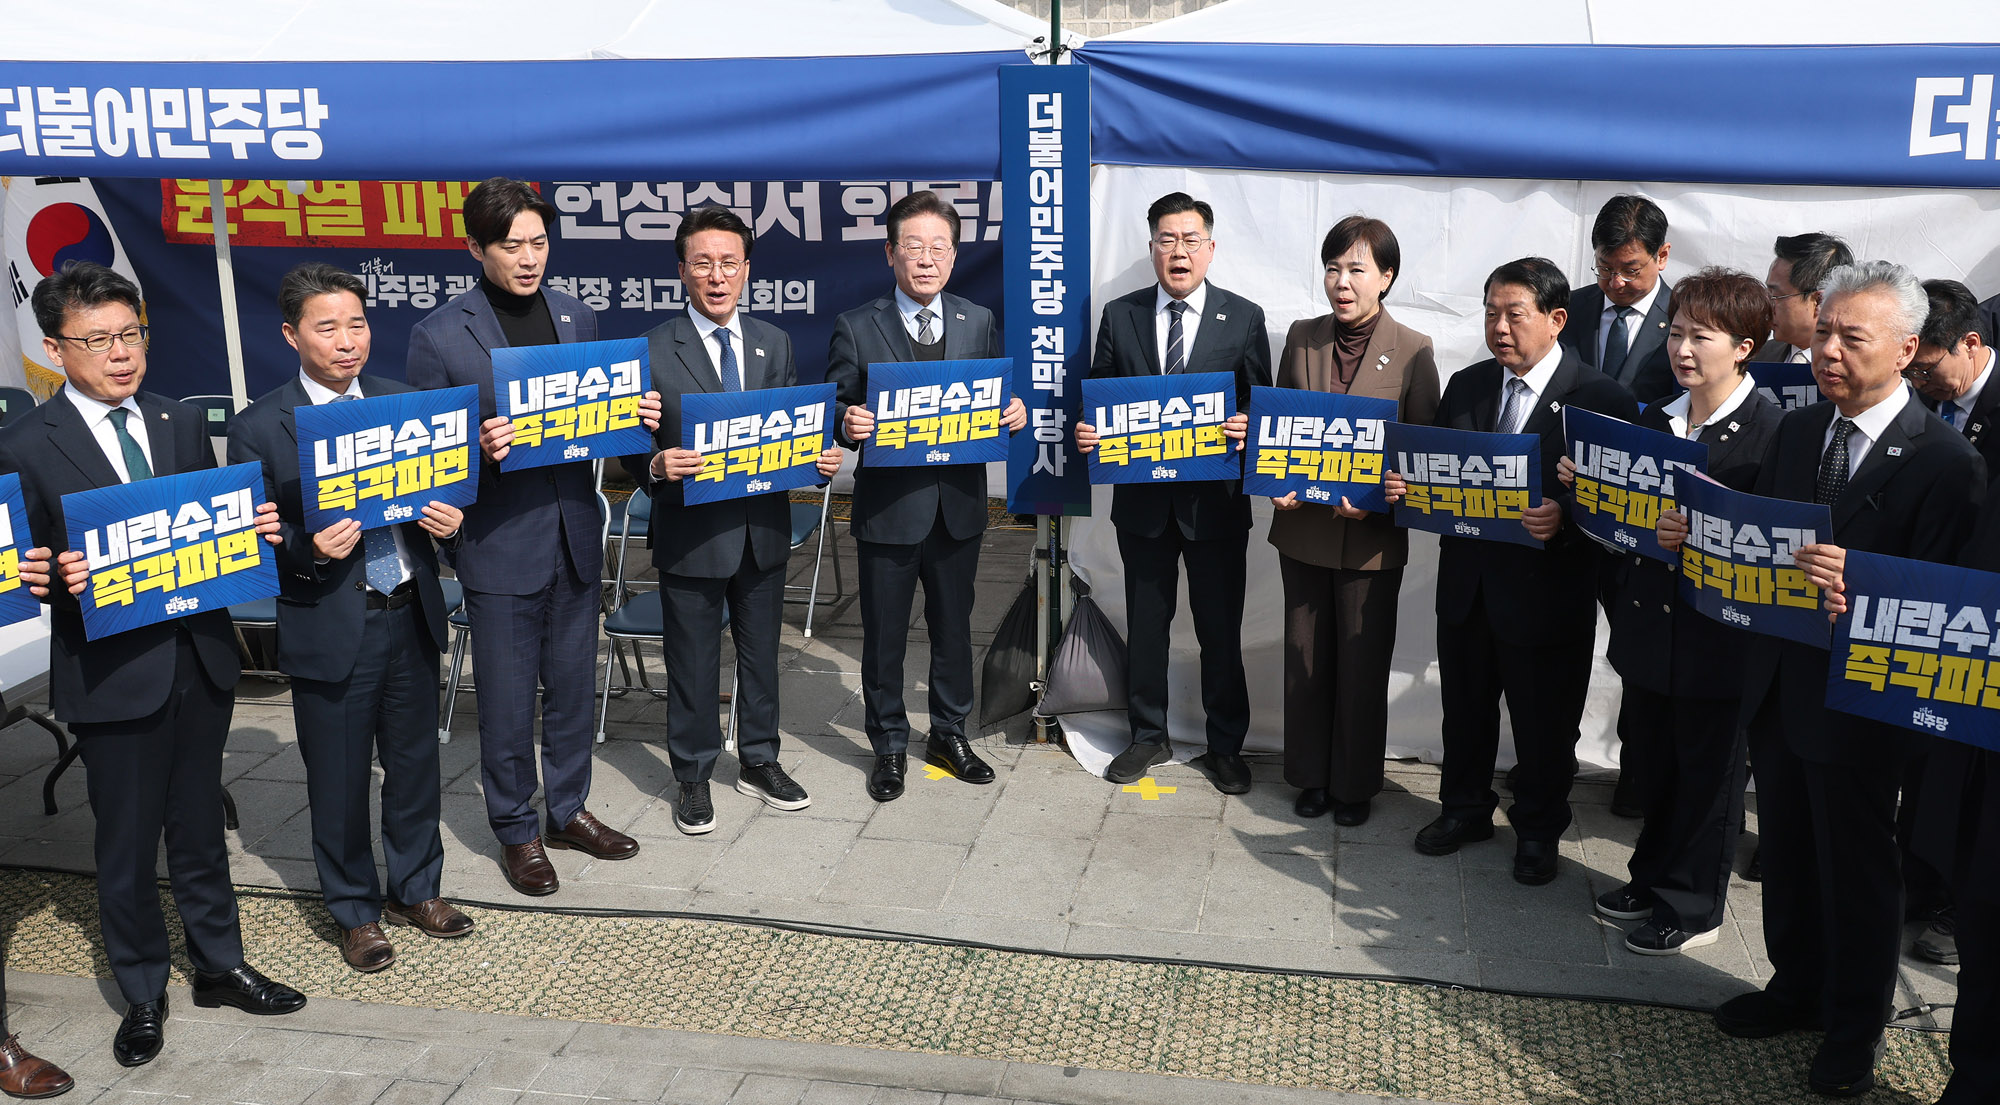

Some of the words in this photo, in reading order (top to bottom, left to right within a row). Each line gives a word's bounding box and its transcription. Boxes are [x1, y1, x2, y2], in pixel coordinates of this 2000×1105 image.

[0, 86, 328, 160] 더불어민주당
[1909, 74, 2000, 160] 더
[379, 181, 531, 238] 파
[1028, 92, 1067, 315] 더불어민주당
[360, 257, 394, 277] 더불어
[620, 277, 816, 314] 최고회의
[1031, 325, 1067, 397] 천막
[509, 360, 641, 416] 내란수괴
[877, 377, 1002, 418] 내란수괴
[511, 395, 642, 447] 즉각파면
[694, 402, 826, 453] 내란수괴
[876, 409, 1001, 449] 즉각파면
[1095, 391, 1225, 436] 내란수괴
[1257, 416, 1384, 451] 내란수괴
[314, 408, 468, 477] 내란수괴
[563, 446, 589, 460] 민주당
[699, 433, 825, 483] 즉각파면
[925, 451, 951, 463] 민주당
[1033, 408, 1068, 477] 당사
[1097, 425, 1228, 466] 즉각파면
[318, 446, 469, 511] 즉각파면
[746, 480, 772, 493] 민주당
[1151, 467, 1178, 480] 민주당
[1256, 449, 1384, 484] 즉각파면
[1397, 451, 1529, 488] 내란수괴
[383, 506, 413, 520] 민주당
[1305, 487, 1331, 501] 민주당
[1403, 484, 1530, 520] 즉각파면
[1576, 477, 1678, 531] 즉각파
[85, 488, 254, 571] 내란수괴
[1454, 523, 1481, 537] 민주당
[1613, 529, 1638, 548] 민주당
[1680, 505, 1816, 565] 내란수괴
[92, 529, 260, 609] 즉각파면
[1682, 545, 1819, 610] 즉각파면
[165, 599, 199, 615] 민주당
[1721, 608, 1751, 627] 민주당
[1912, 710, 1949, 732] 민주당
